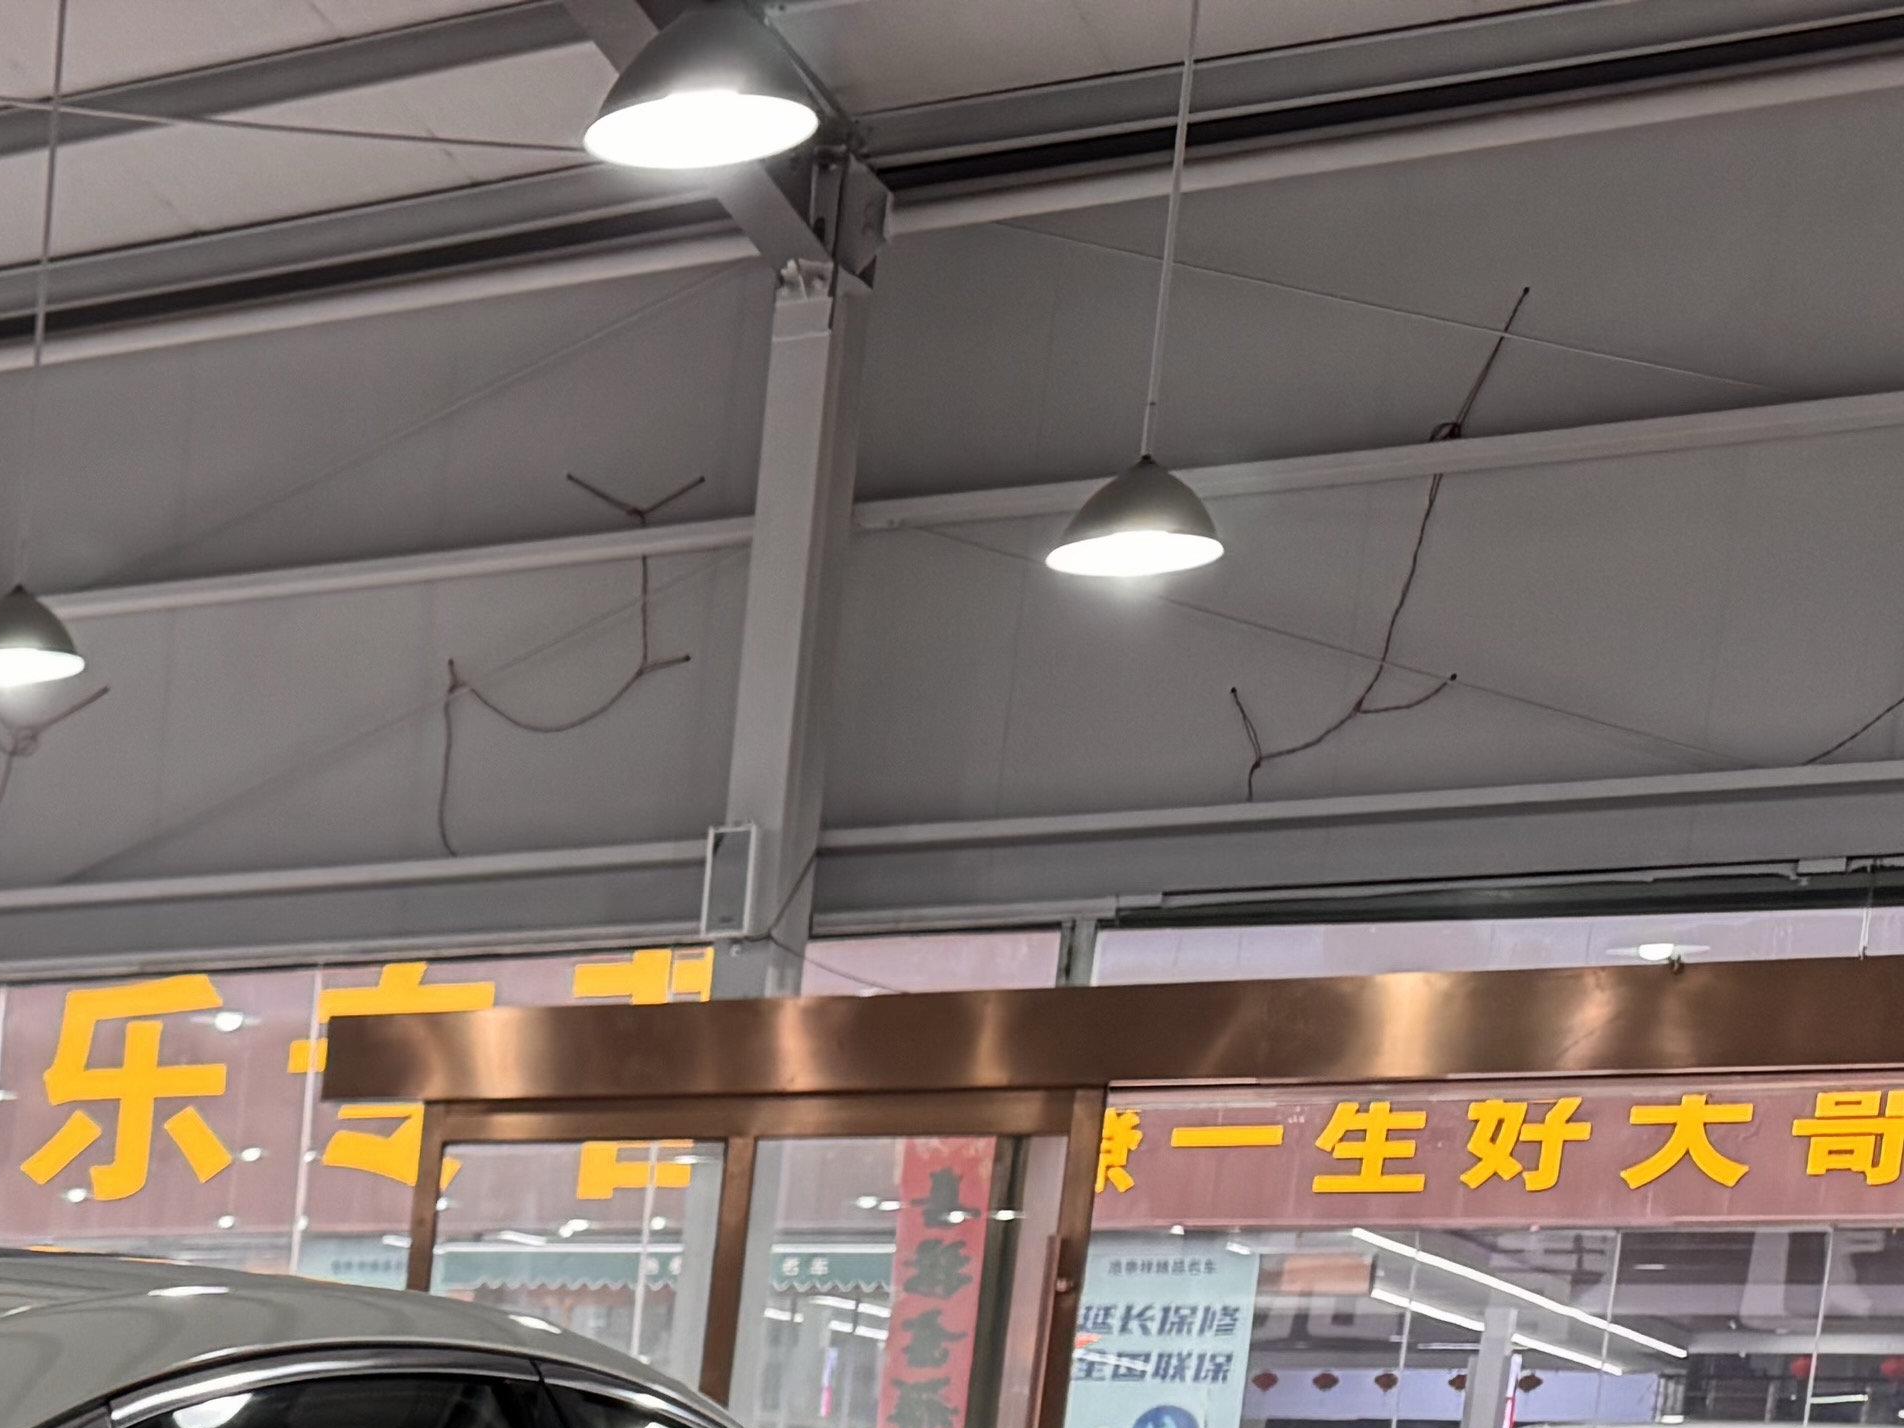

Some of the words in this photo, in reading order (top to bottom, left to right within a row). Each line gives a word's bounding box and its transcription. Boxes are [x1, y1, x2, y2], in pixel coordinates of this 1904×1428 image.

[1079, 1304, 1239, 1336] 延长保修
[1071, 1348, 1234, 1383] 全国联保
